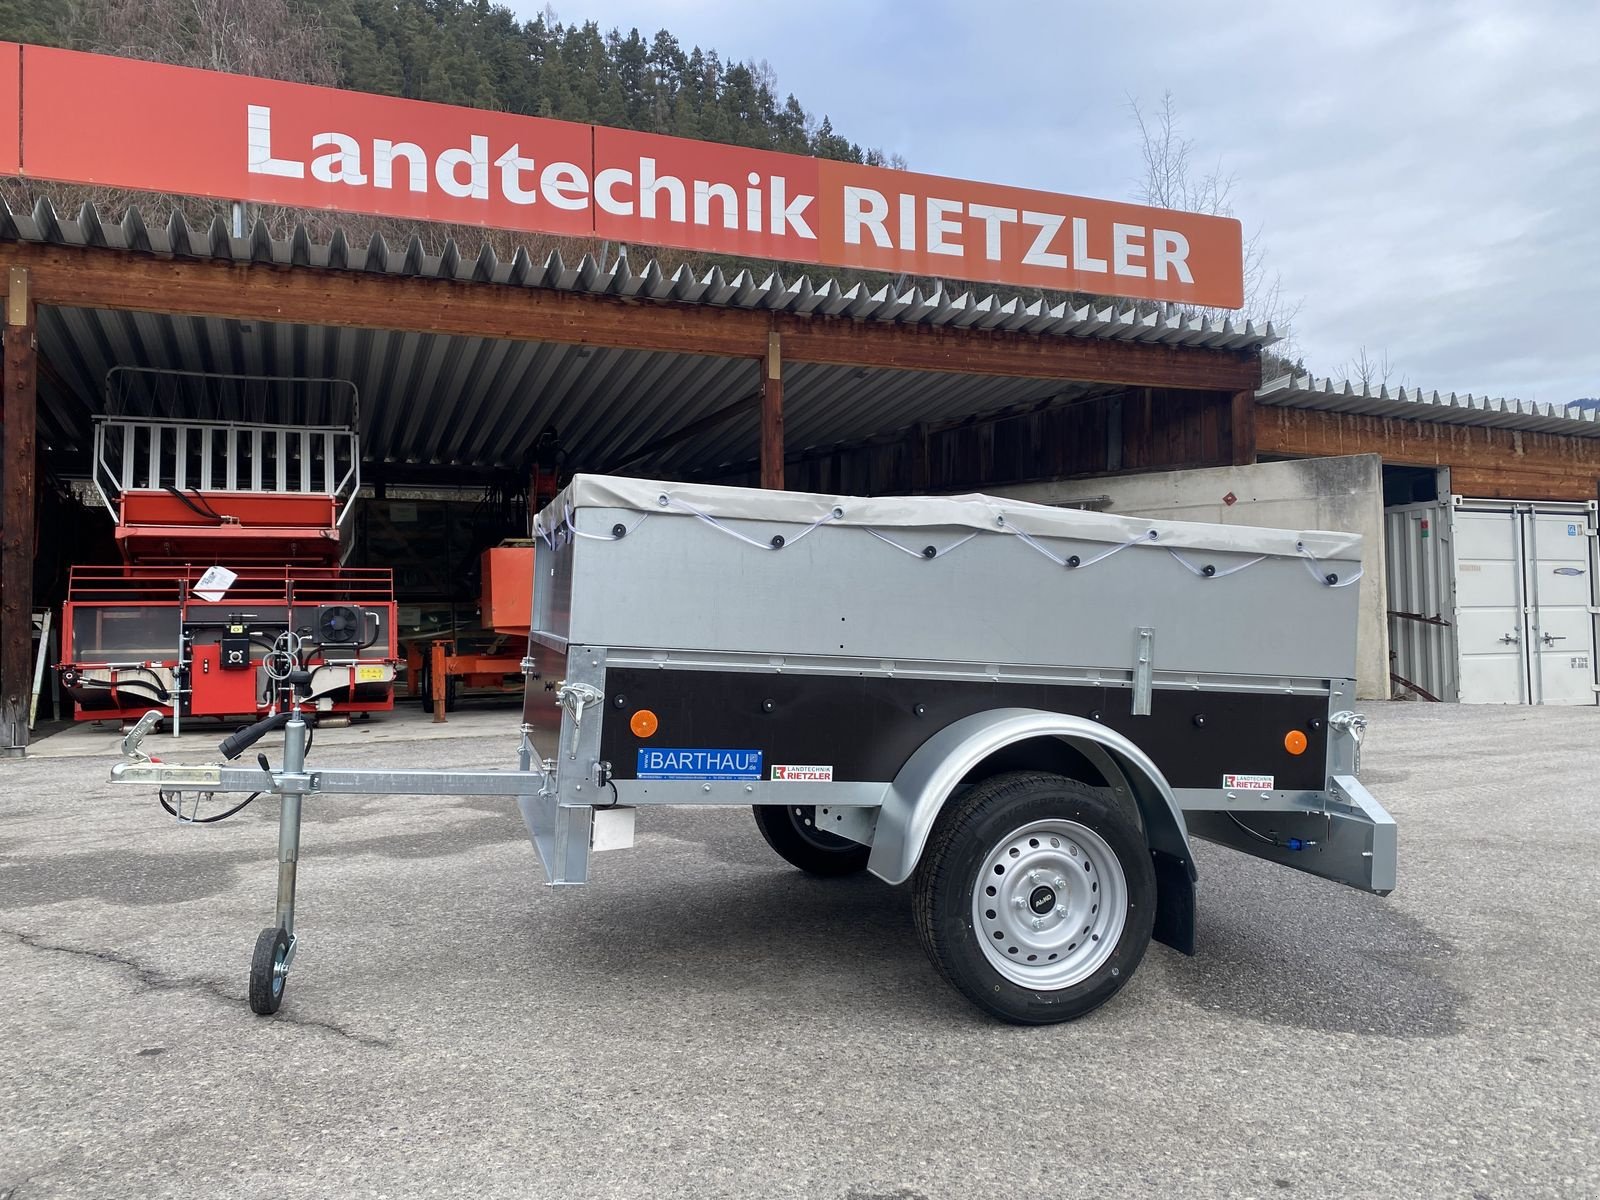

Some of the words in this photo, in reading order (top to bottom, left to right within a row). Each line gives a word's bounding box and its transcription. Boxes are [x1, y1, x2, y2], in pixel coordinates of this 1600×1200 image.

[247, 104, 818, 240] Landtechnik
[843, 185, 1195, 285] RIETZLER
[650, 752, 749, 770] BARTHAU
[787, 772, 831, 780] RIETZLER
[1236, 781, 1272, 789] RIETZLER
